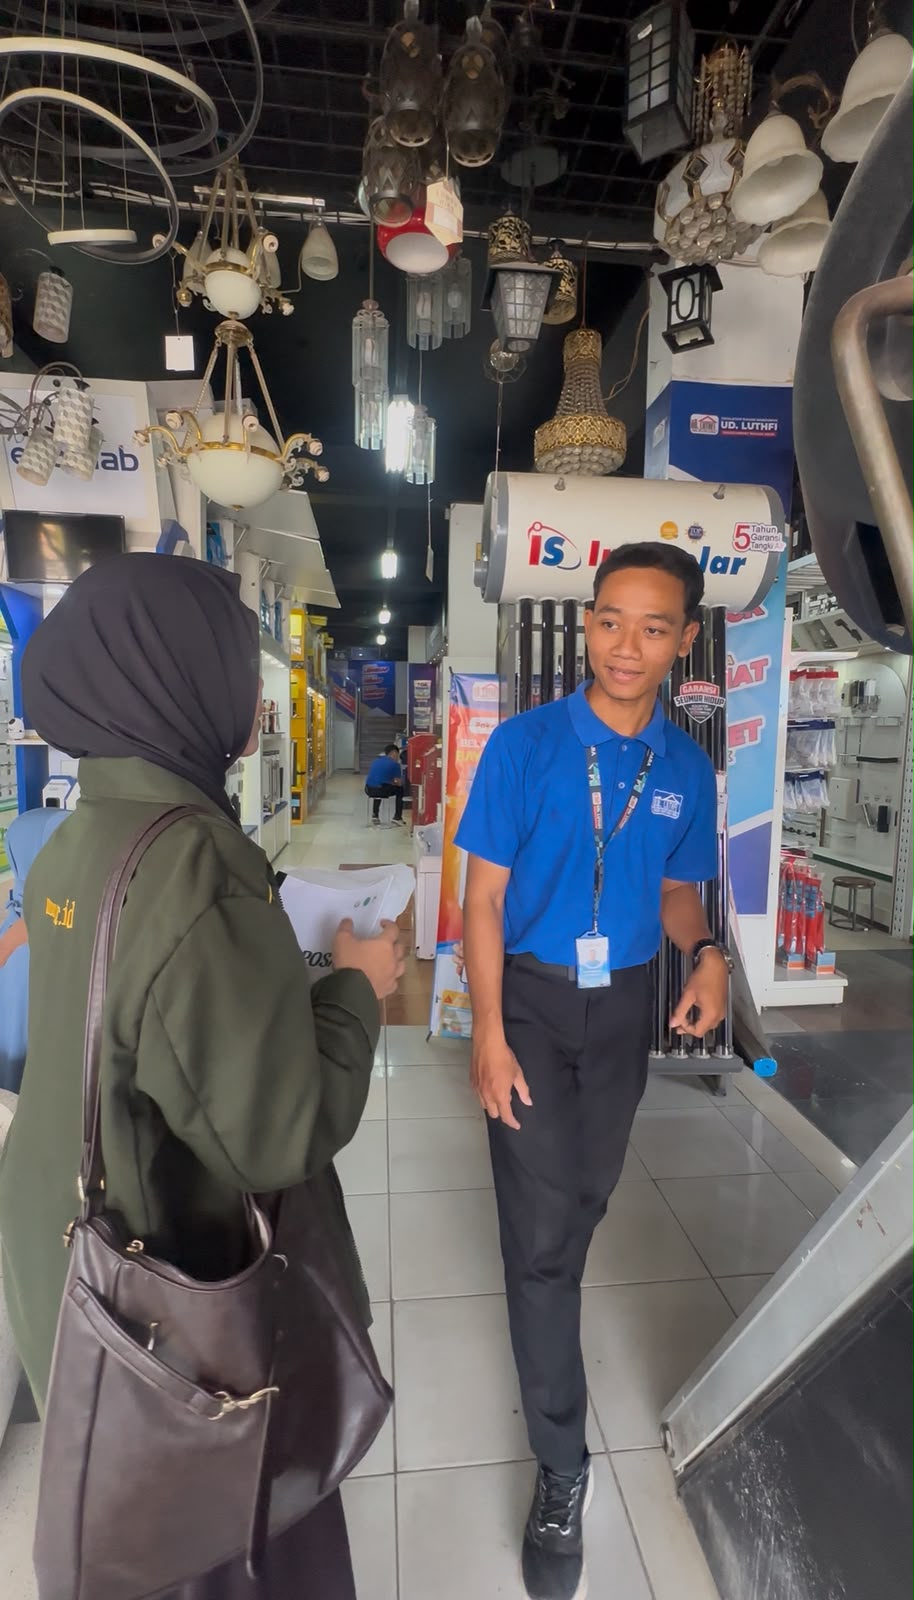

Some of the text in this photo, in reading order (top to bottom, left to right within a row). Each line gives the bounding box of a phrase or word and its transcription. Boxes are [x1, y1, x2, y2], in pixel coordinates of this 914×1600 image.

[720, 421, 738, 430] UD.
[741, 421, 778, 431] LUTHFI
[734, 525, 776, 550] 5 Tahun
[751, 533, 780, 542] Garansi
[698, 546, 748, 575] lar
[682, 685, 717, 695] GARANSI
[303, 951, 333, 967] POS
